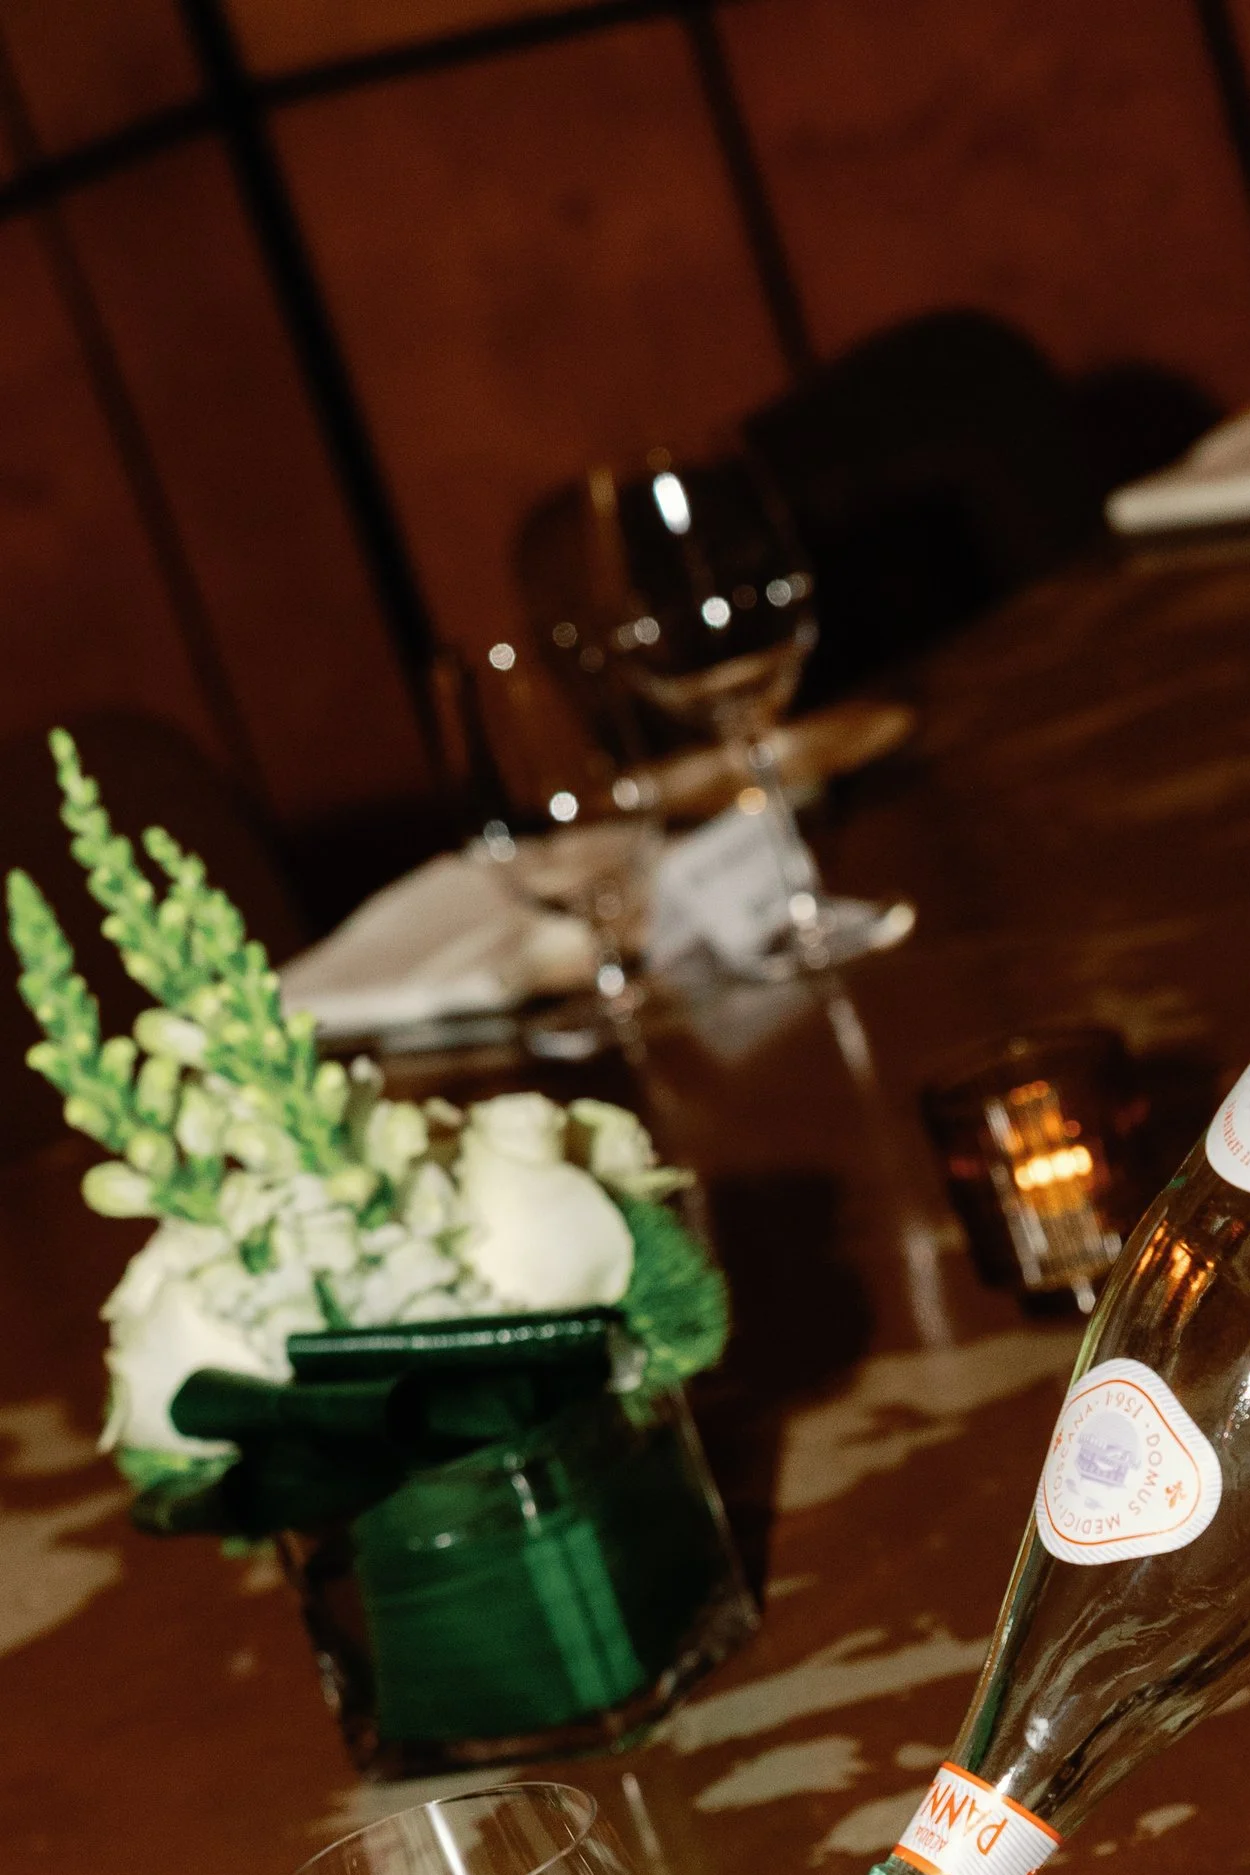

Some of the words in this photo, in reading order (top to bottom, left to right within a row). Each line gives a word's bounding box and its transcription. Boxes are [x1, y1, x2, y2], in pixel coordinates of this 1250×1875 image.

[1105, 1390, 1144, 1419] 1564
[1128, 1432, 1163, 1516] DOMUS
[1060, 1510, 1121, 1535] MEDICI
[920, 1780, 1008, 1856] PANN
